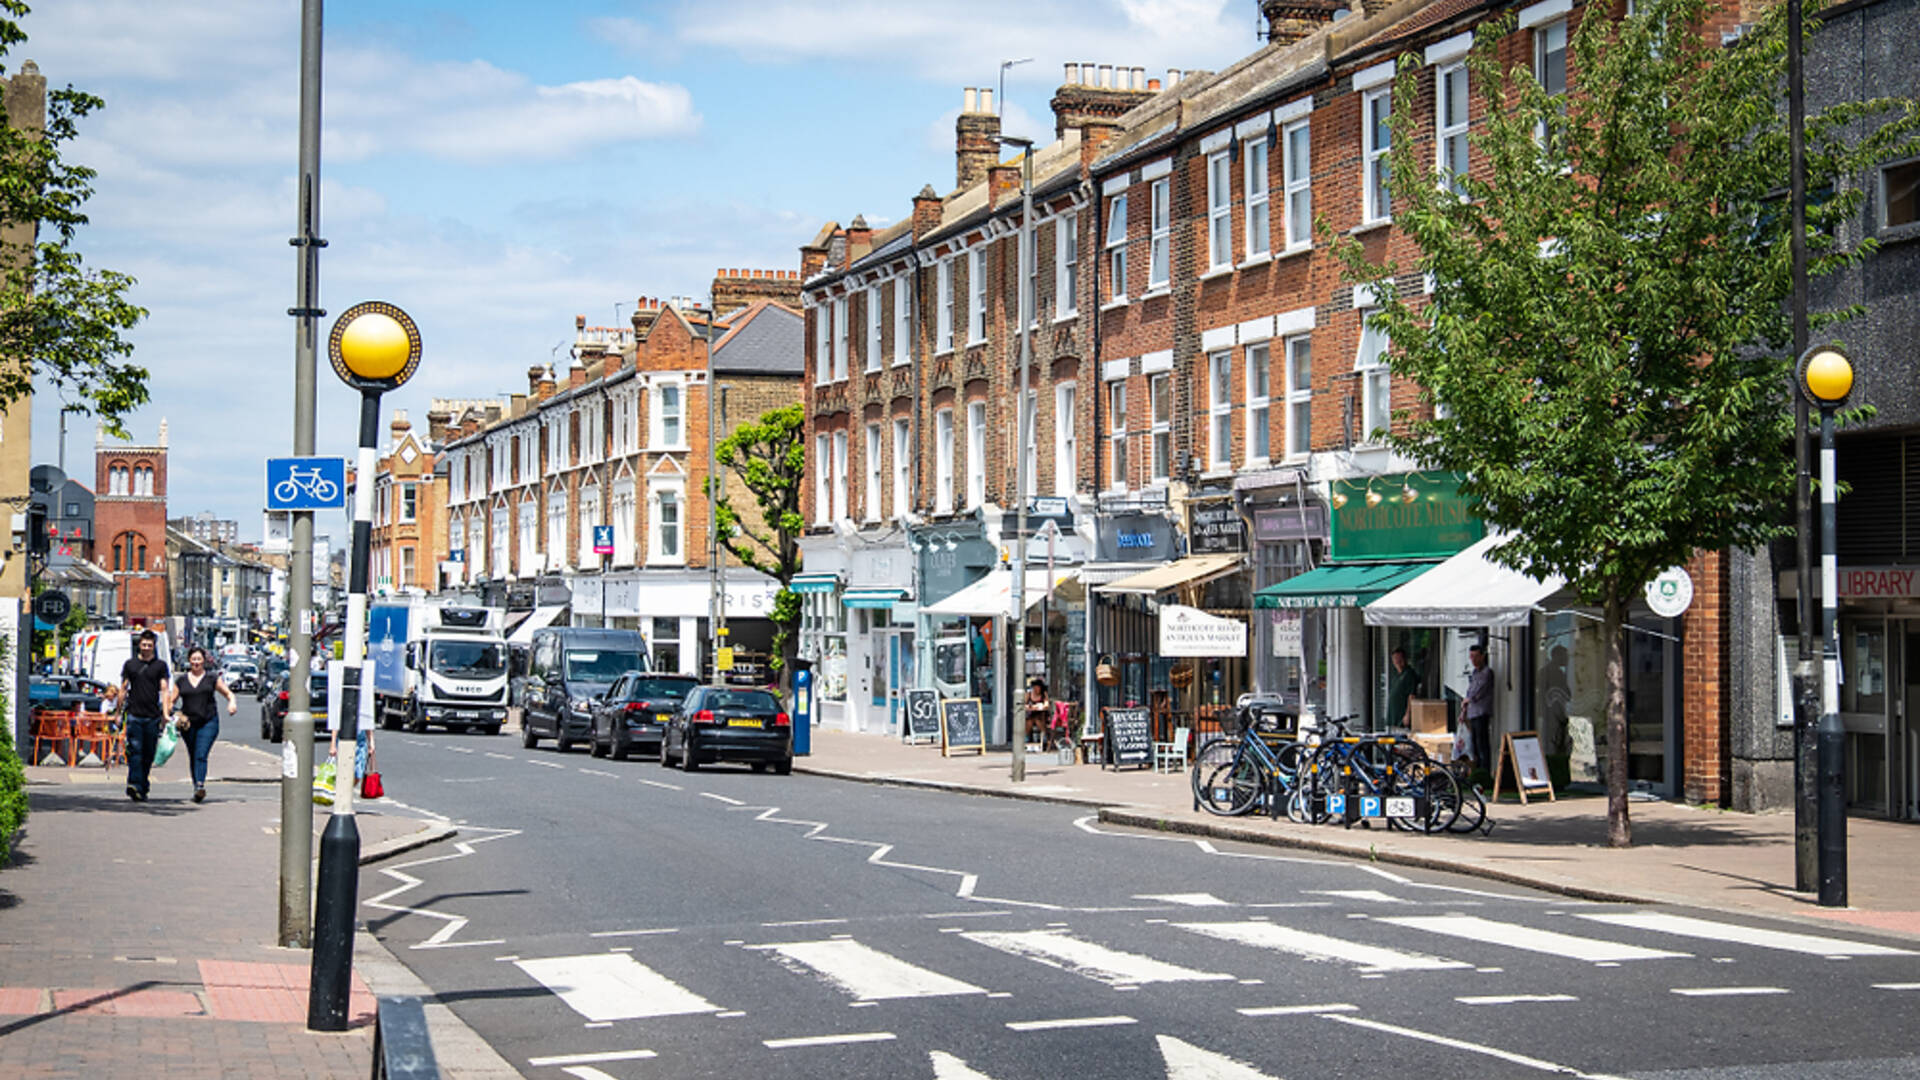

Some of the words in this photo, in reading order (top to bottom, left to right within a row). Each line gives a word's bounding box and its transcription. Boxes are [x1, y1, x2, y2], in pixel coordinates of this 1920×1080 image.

[1338, 505, 1421, 531] NORTHCOTE
[1424, 499, 1472, 526] MUSIC
[1837, 570, 1915, 596] LIBRARY
[455, 685, 482, 693] IVECO
[1111, 711, 1145, 722] HUGE
[1330, 796, 1342, 813] P
[1364, 798, 1377, 817] P
